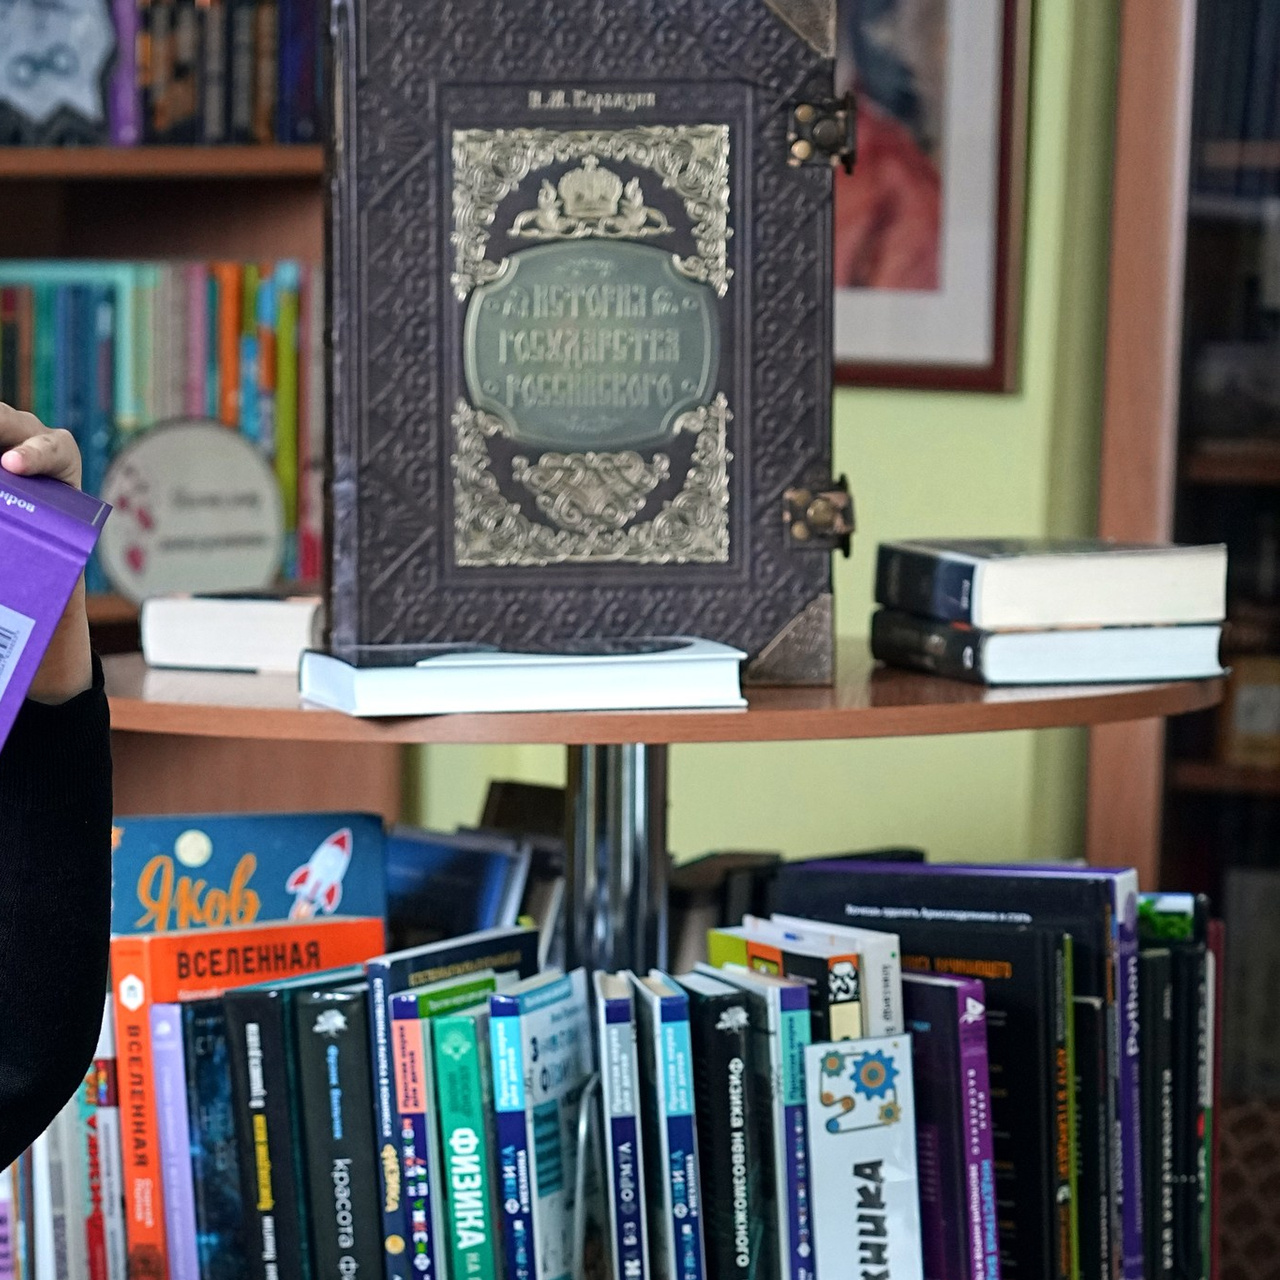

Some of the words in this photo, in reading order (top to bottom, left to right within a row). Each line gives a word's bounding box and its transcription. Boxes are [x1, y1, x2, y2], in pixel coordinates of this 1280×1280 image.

[135, 852, 262, 932] Яков
[176, 940, 321, 980] ВСЕЛЕННАЯ
[1124, 955, 1140, 1056] Python
[126, 1024, 150, 1168] ВСЕЛЕННАЯ
[727, 1057, 746, 1129] Физика
[329, 1158, 356, 1249] красота
[448, 1127, 487, 1250] ФИЗИКА
[729, 1131, 751, 1268] невозможного
[980, 1158, 997, 1254] ИНДУСТРИЯ
[464, 1251, 480, 1274] НА
